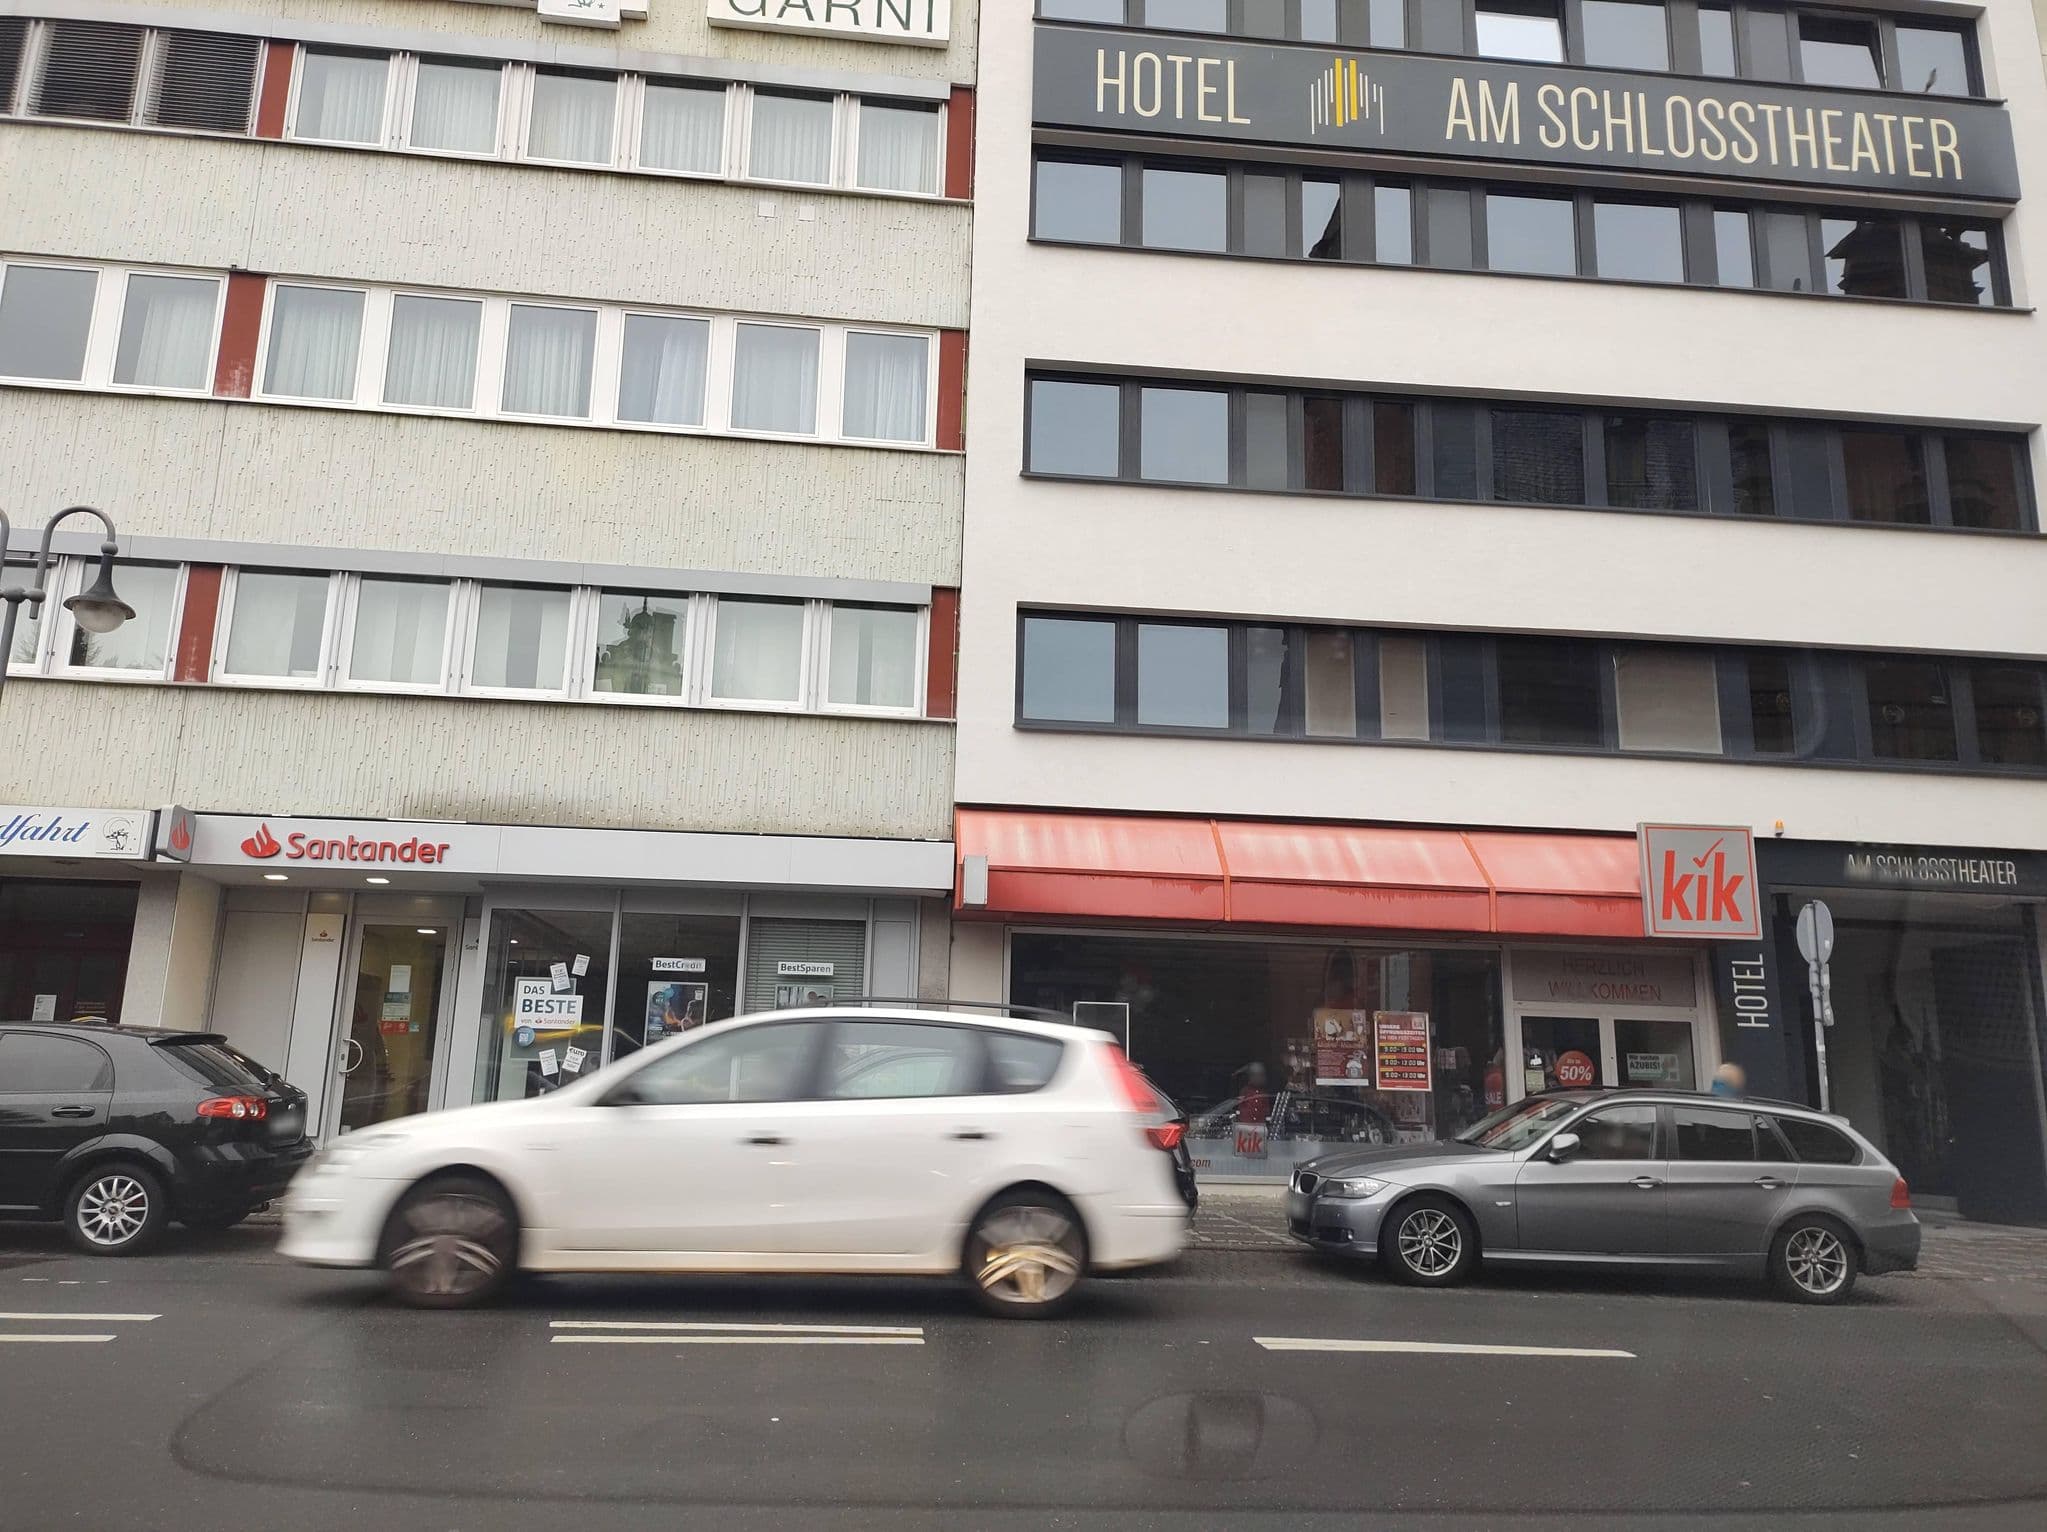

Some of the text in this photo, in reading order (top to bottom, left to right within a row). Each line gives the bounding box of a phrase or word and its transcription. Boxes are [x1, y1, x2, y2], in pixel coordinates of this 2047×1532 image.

[1096, 48, 1251, 125] HOTEL
[1445, 77, 1964, 180] AM SCHLOSSTHEATER
[286, 832, 450, 864] Santander
[1662, 838, 1745, 922] kik
[1847, 853, 2018, 886] AM SCHLOSSTHEATER
[780, 963, 831, 974] BestSparen
[1562, 954, 1646, 977] HERZLICH
[523, 985, 545, 995] DAS
[1731, 953, 1770, 1028] HOTEL
[521, 998, 577, 1014] BESTE
[1559, 1065, 1593, 1081] 50%
[1236, 1128, 1262, 1153] kik
